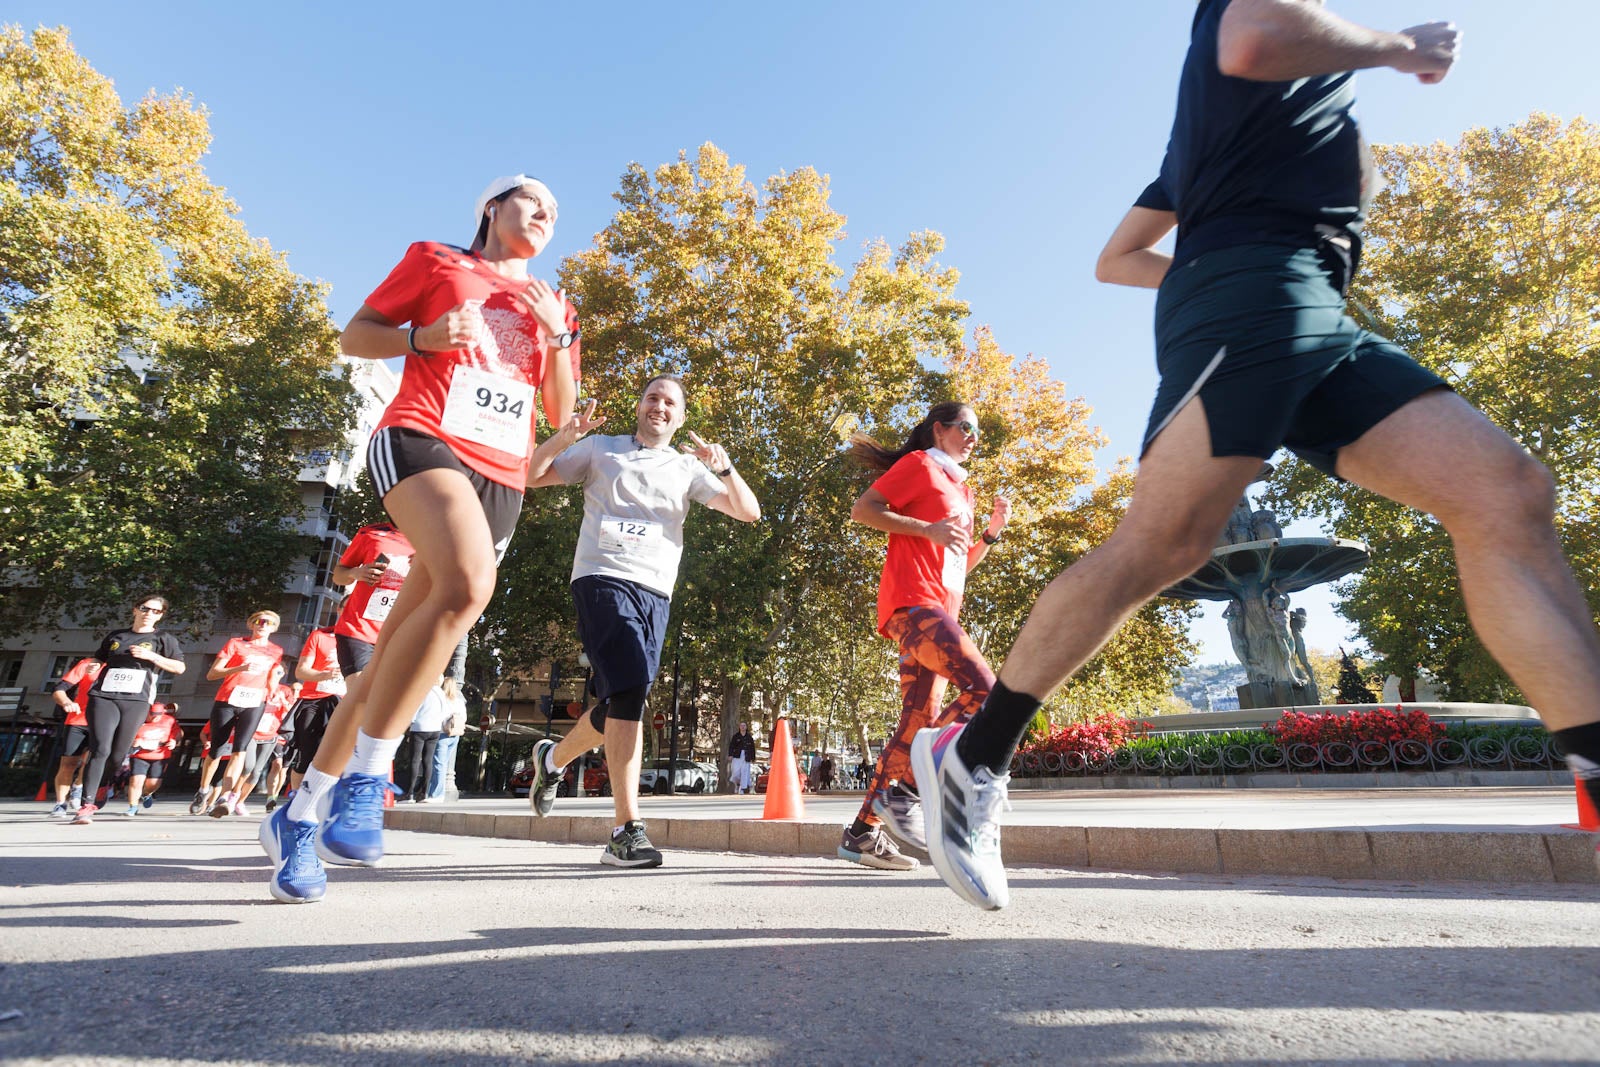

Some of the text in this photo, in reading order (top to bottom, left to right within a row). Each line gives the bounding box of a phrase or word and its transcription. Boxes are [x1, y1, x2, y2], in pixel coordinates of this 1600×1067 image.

[475, 387, 525, 419] 934
[617, 521, 647, 537] 122
[113, 673, 133, 682] 599
